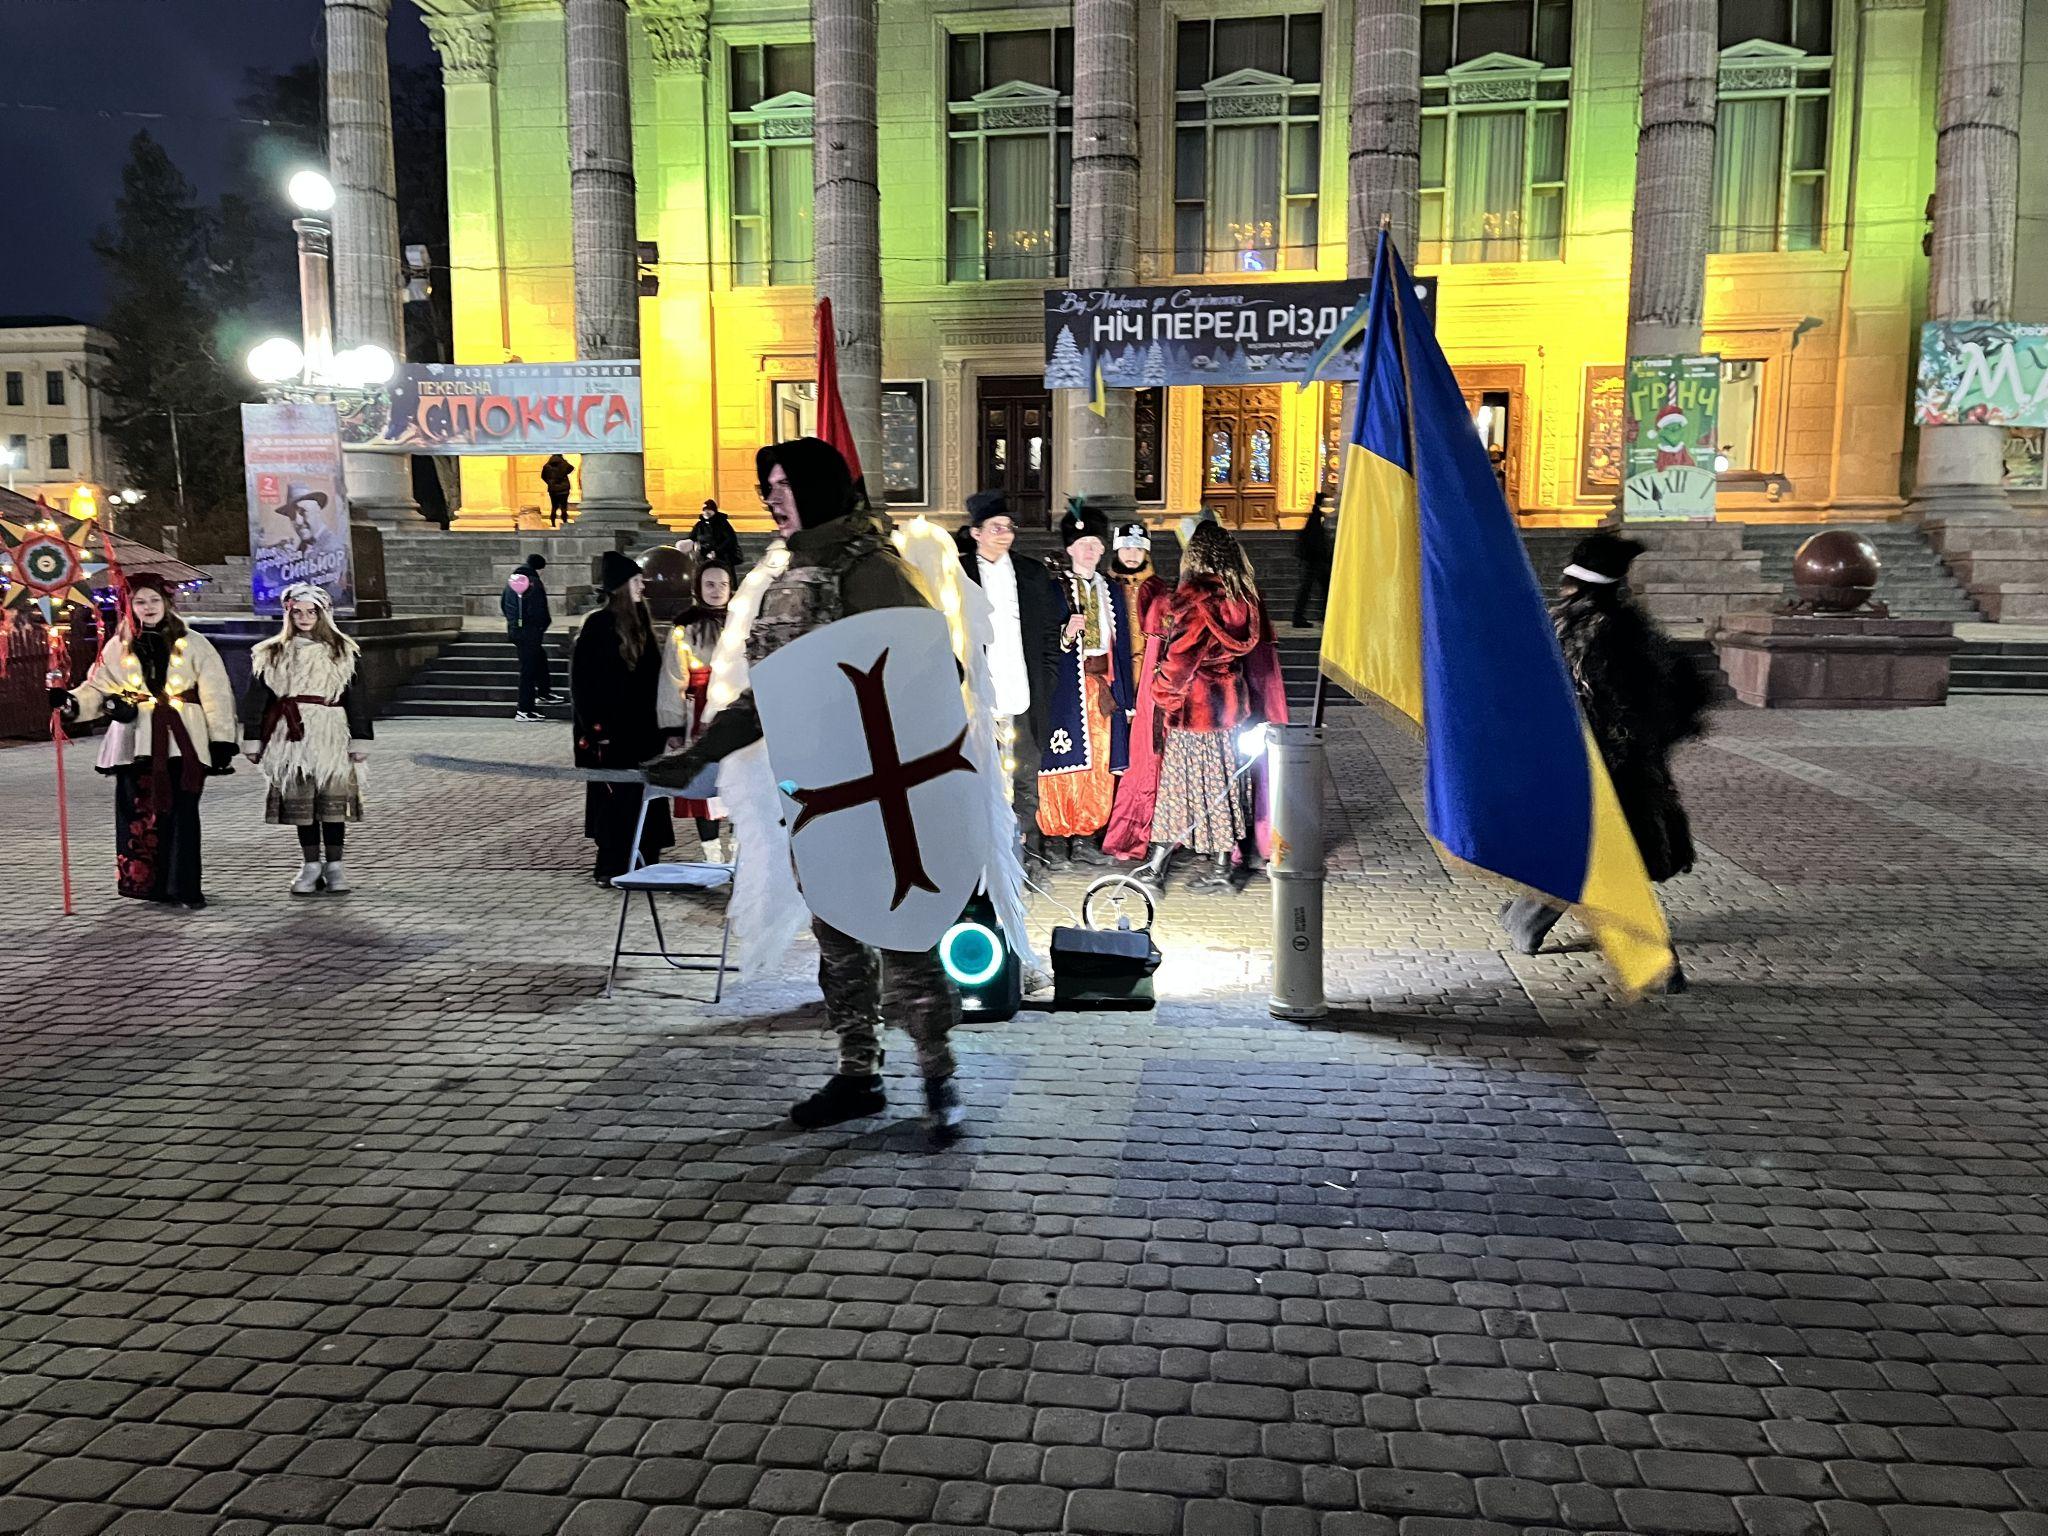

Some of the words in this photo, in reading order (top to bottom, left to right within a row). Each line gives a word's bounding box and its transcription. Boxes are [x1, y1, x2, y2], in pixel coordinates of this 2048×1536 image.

[1152, 309, 1259, 342] ПЕРЕД
[417, 381, 492, 395] ПЕКЕЛЬНА
[416, 395, 633, 444] СПОКУСА
[263, 477, 274, 492] 2
[281, 550, 345, 581] СИНЬЙОР
